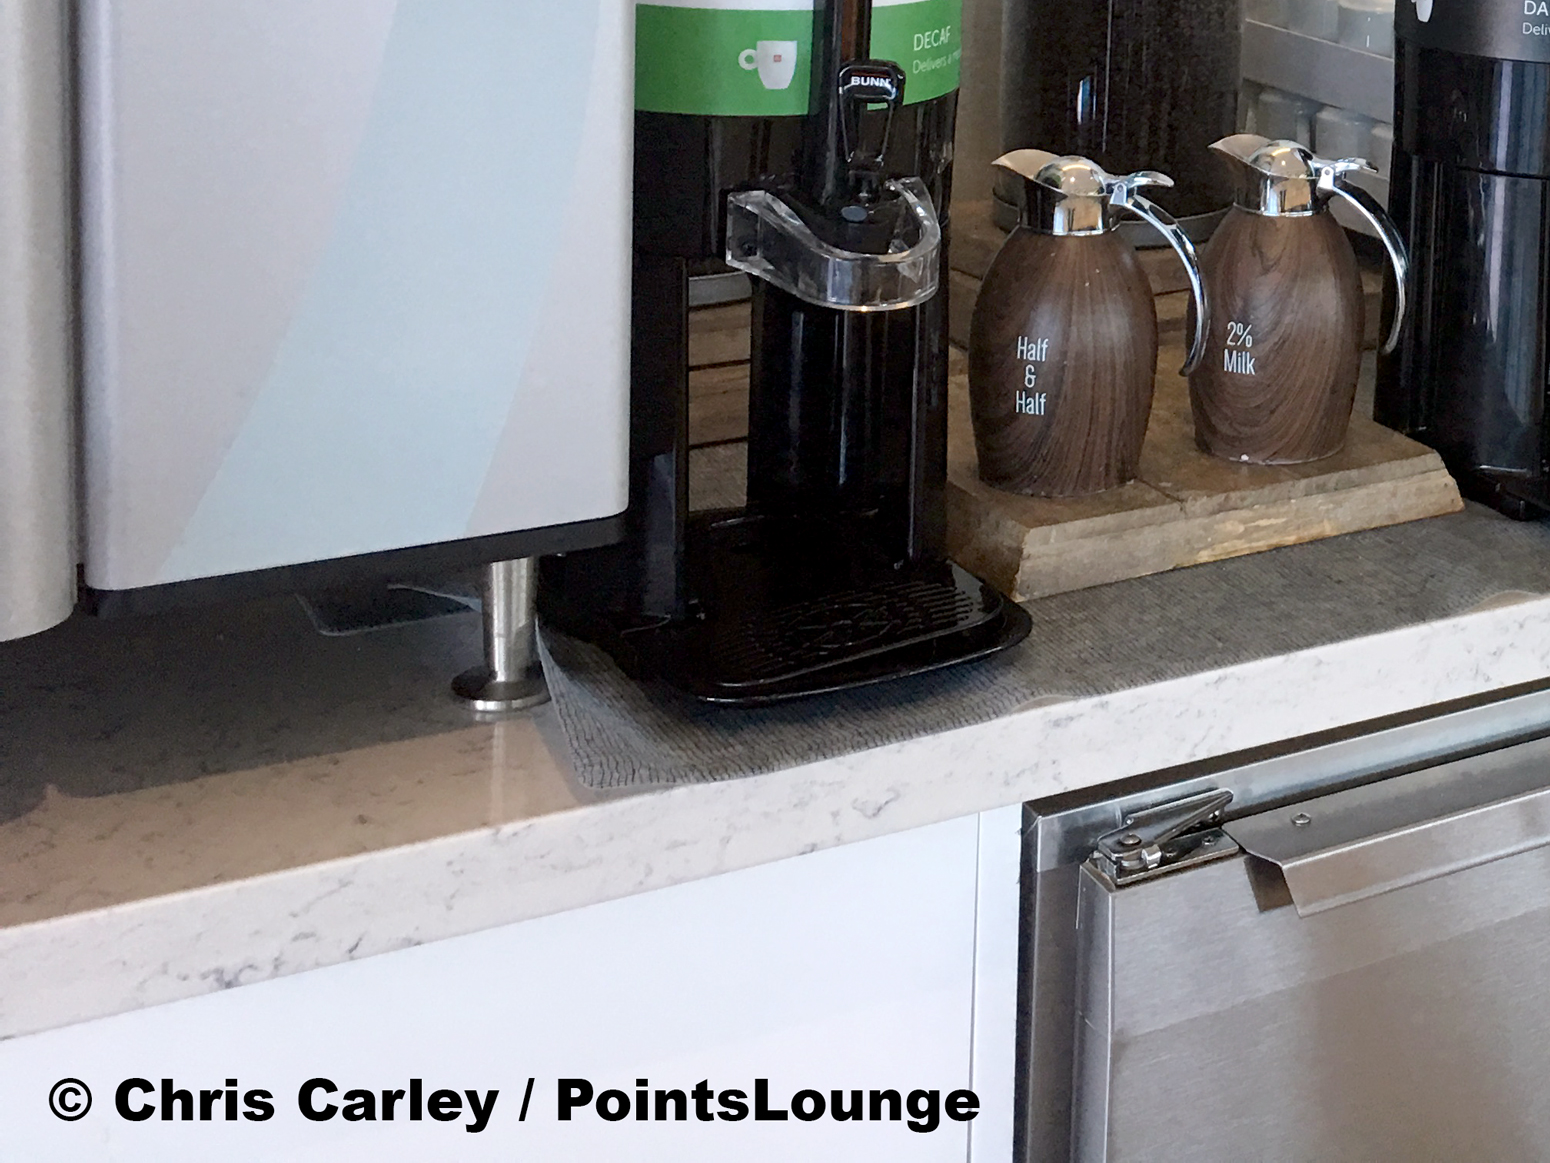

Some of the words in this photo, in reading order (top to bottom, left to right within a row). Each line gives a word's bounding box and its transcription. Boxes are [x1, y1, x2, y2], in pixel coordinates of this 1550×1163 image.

[913, 25, 951, 51] DECAF
[912, 55, 947, 74] Delivers
[851, 76, 889, 87] BUNN
[1227, 321, 1253, 349] 2%
[1017, 336, 1048, 362] Half
[1224, 349, 1256, 376] Milk
[1025, 364, 1036, 388] &
[1015, 391, 1046, 416] Half
